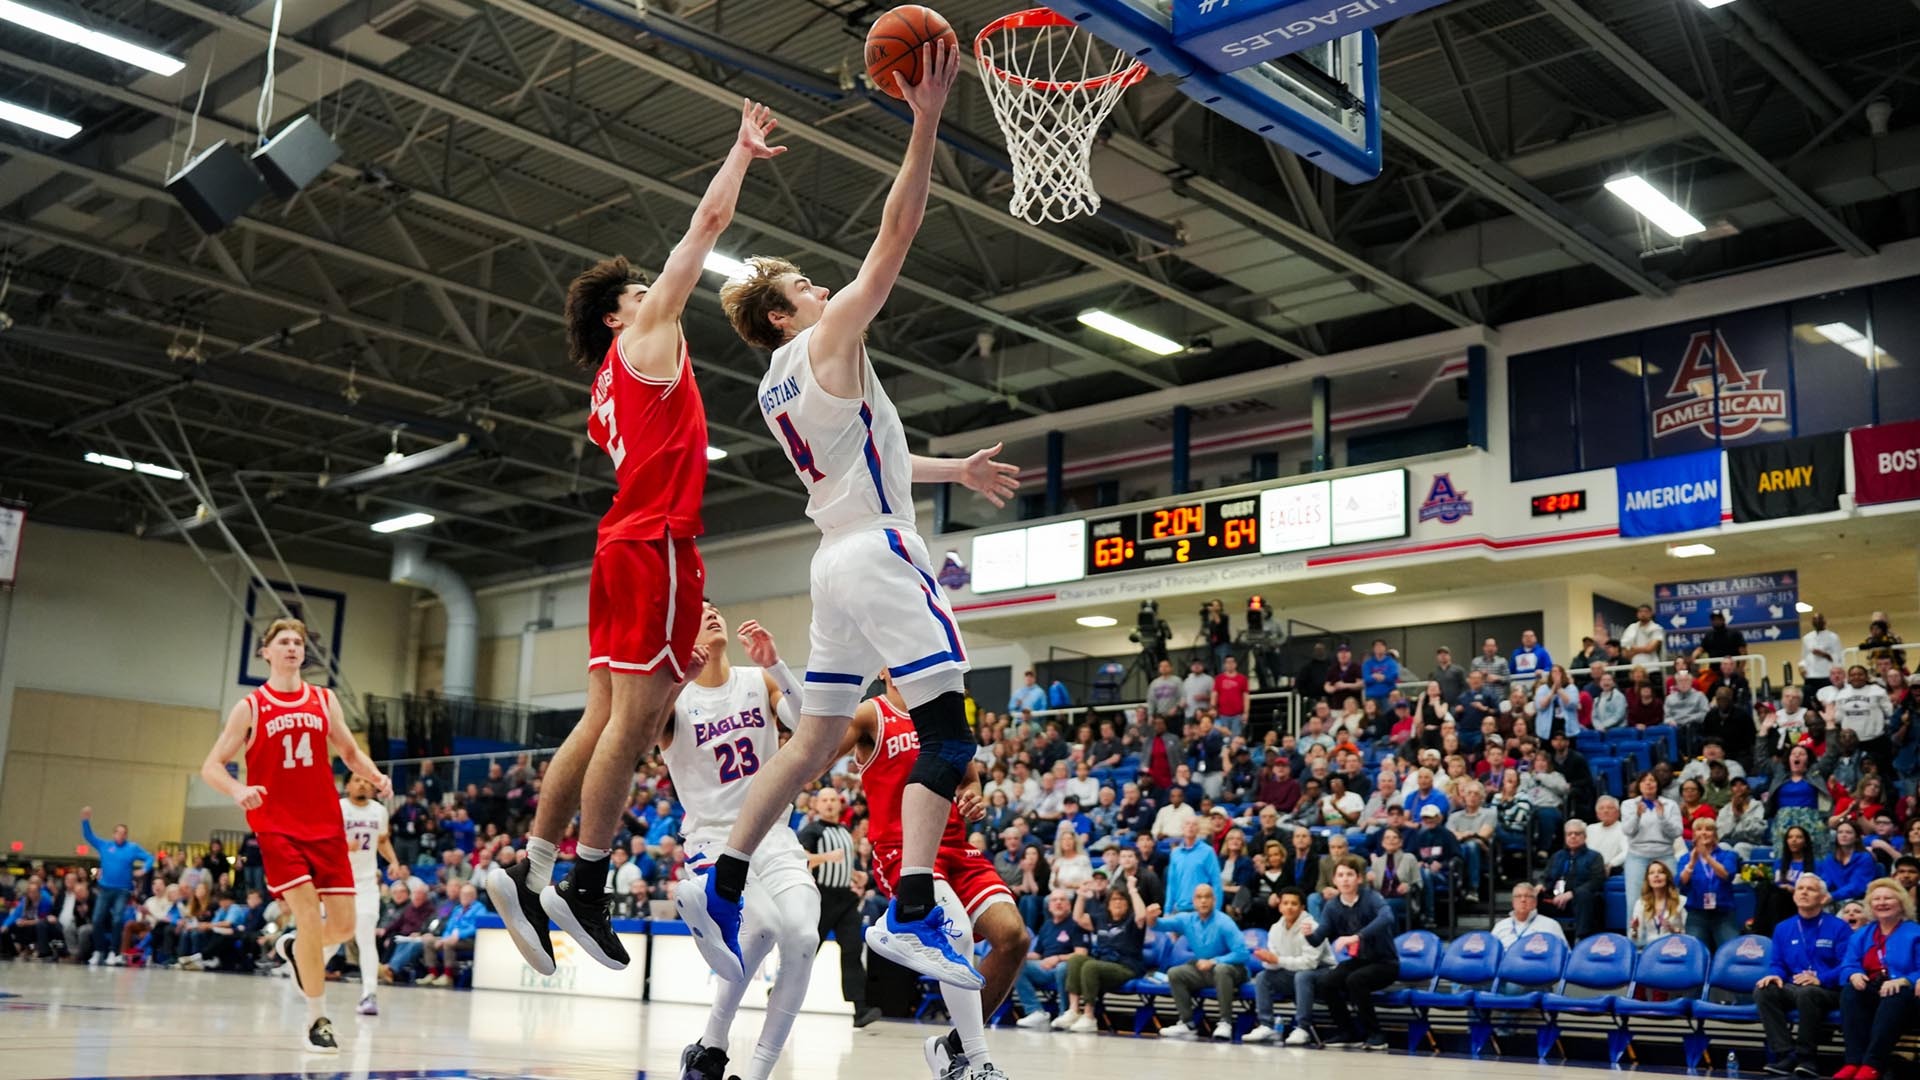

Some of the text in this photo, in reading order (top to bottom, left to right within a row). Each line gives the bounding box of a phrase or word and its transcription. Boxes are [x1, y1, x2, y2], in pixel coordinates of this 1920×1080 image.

[1660, 396, 1779, 430] AMERICAN
[597, 397, 627, 471] 2
[775, 411, 827, 484] 4
[1624, 479, 1718, 512] AMERICAN
[1758, 465, 1813, 494] ARMY
[1153, 505, 1203, 539] 2:04
[1224, 518, 1256, 549] 64
[1095, 536, 1124, 567] 63
[1176, 539, 1190, 562] 2
[1060, 559, 1305, 601] Character Forged Through Competition
[1677, 575, 1776, 597] BENDER ARENA
[1711, 595, 1739, 609] EXIT
[265, 712, 323, 738] BOSTON
[694, 707, 765, 747] EAGLES
[282, 732, 314, 769] 14
[713, 736, 760, 784] 23
